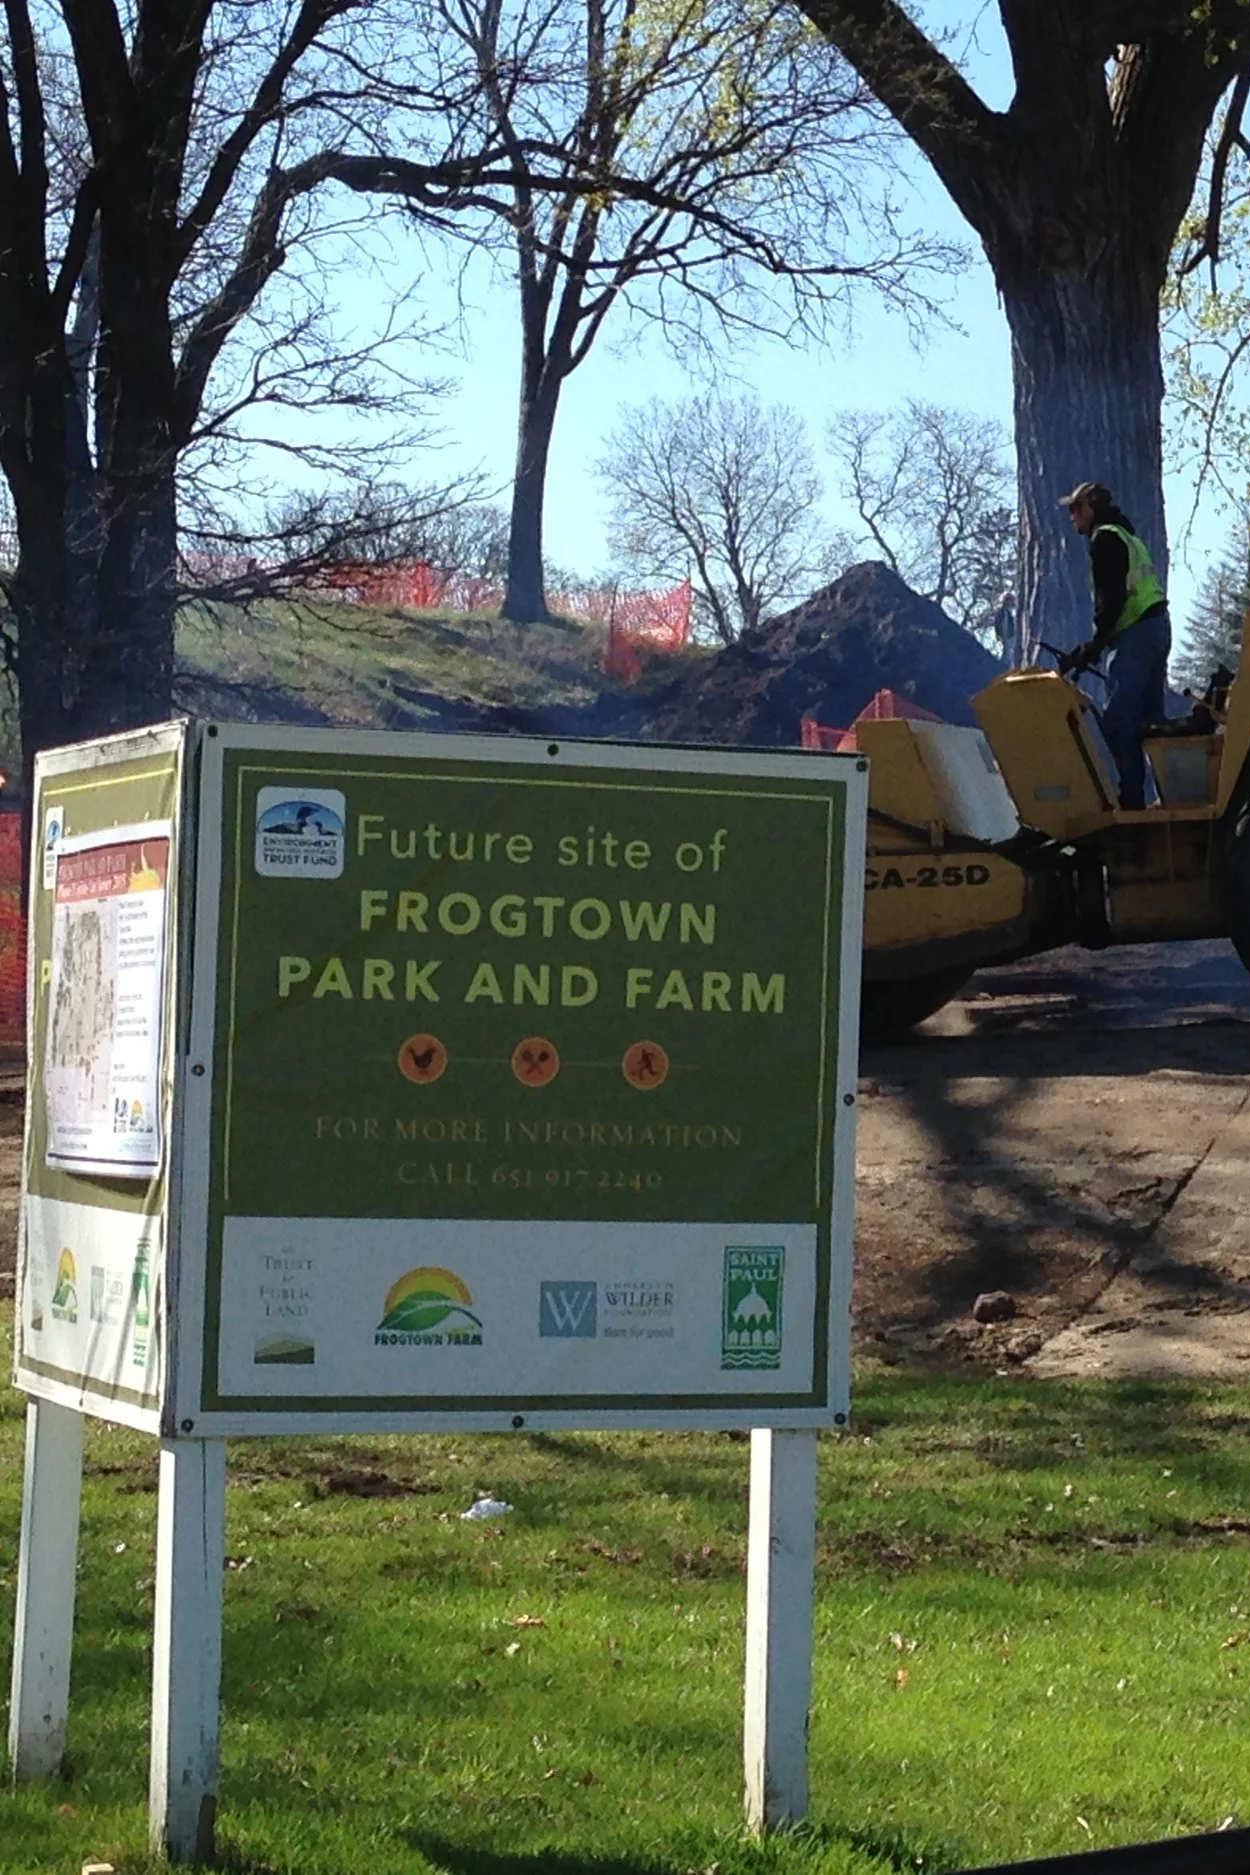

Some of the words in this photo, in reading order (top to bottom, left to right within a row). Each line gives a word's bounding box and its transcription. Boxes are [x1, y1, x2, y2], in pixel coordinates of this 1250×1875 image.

[356, 814, 534, 865] Future
[557, 825, 652, 870] site
[675, 828, 728, 873] of
[263, 853, 300, 865] TRUST
[303, 855, 338, 866] FUND
[865, 864, 991, 890] CA-25D
[360, 889, 716, 945] FROGTOWN
[277, 955, 443, 1002] PARK
[463, 962, 599, 1007] AND
[625, 968, 786, 1014] FARM
[315, 1115, 380, 1140] FOR
[394, 1117, 489, 1143] MORE
[503, 1118, 742, 1147] INFORMATION
[397, 1160, 479, 1185] CALL
[260, 1254, 313, 1271] TRUST
[730, 1252, 779, 1267] SAINT
[730, 1268, 778, 1281] PAUL
[260, 1284, 313, 1300] PUBLIC
[604, 1291, 675, 1307] WILDER
[264, 1303, 309, 1318] LAND
[374, 1332, 444, 1346] FROGTOWN
[447, 1333, 484, 1346] FARM
